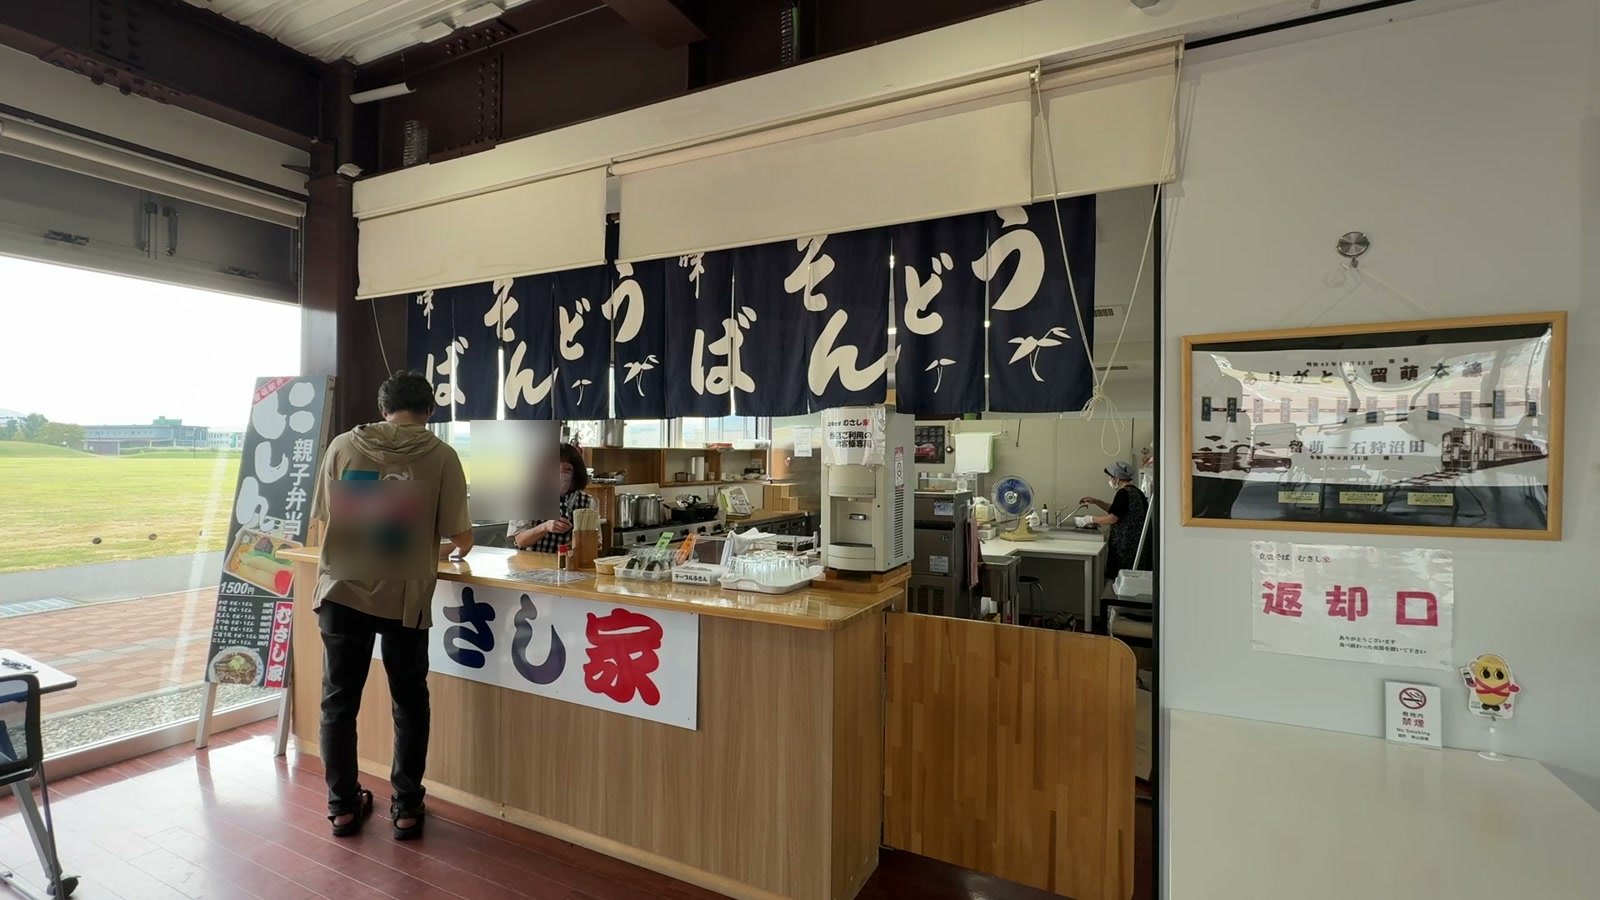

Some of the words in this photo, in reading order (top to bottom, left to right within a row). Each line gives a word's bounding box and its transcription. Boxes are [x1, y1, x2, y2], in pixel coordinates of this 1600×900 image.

[842, 418, 870, 427] むさし家
[283, 438, 314, 536] 親子弁当
[219, 581, 255, 595] 1500円
[1262, 581, 1438, 627] 返却口
[267, 605, 292, 682] むさし家
[443, 587, 663, 706] さし家
[1401, 717, 1425, 728] 禁煙
